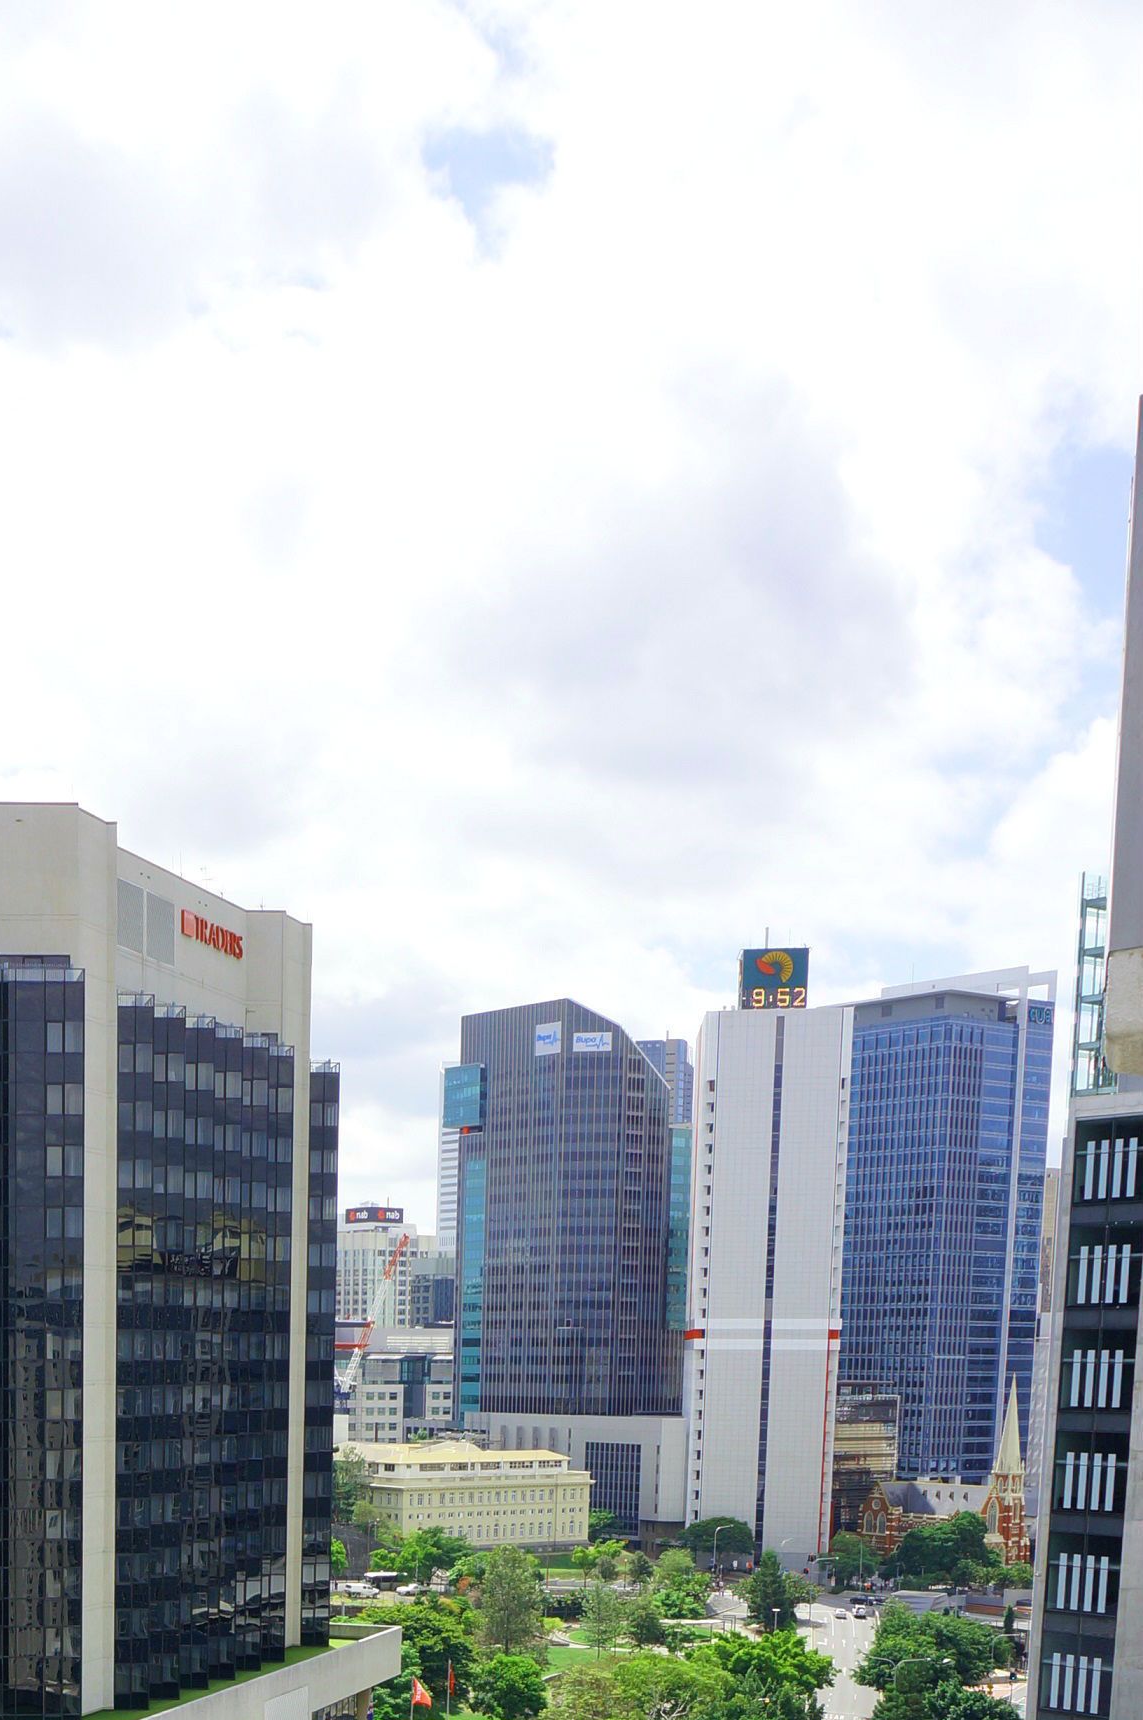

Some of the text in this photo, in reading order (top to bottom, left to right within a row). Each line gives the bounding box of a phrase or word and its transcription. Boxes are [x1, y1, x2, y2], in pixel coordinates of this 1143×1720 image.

[194, 914, 243, 960] TRADERS
[752, 987, 806, 1007] 9:52
[575, 1035, 596, 1044] Bupa
[356, 1210, 368, 1219] nab
[386, 1210, 400, 1219] nab
